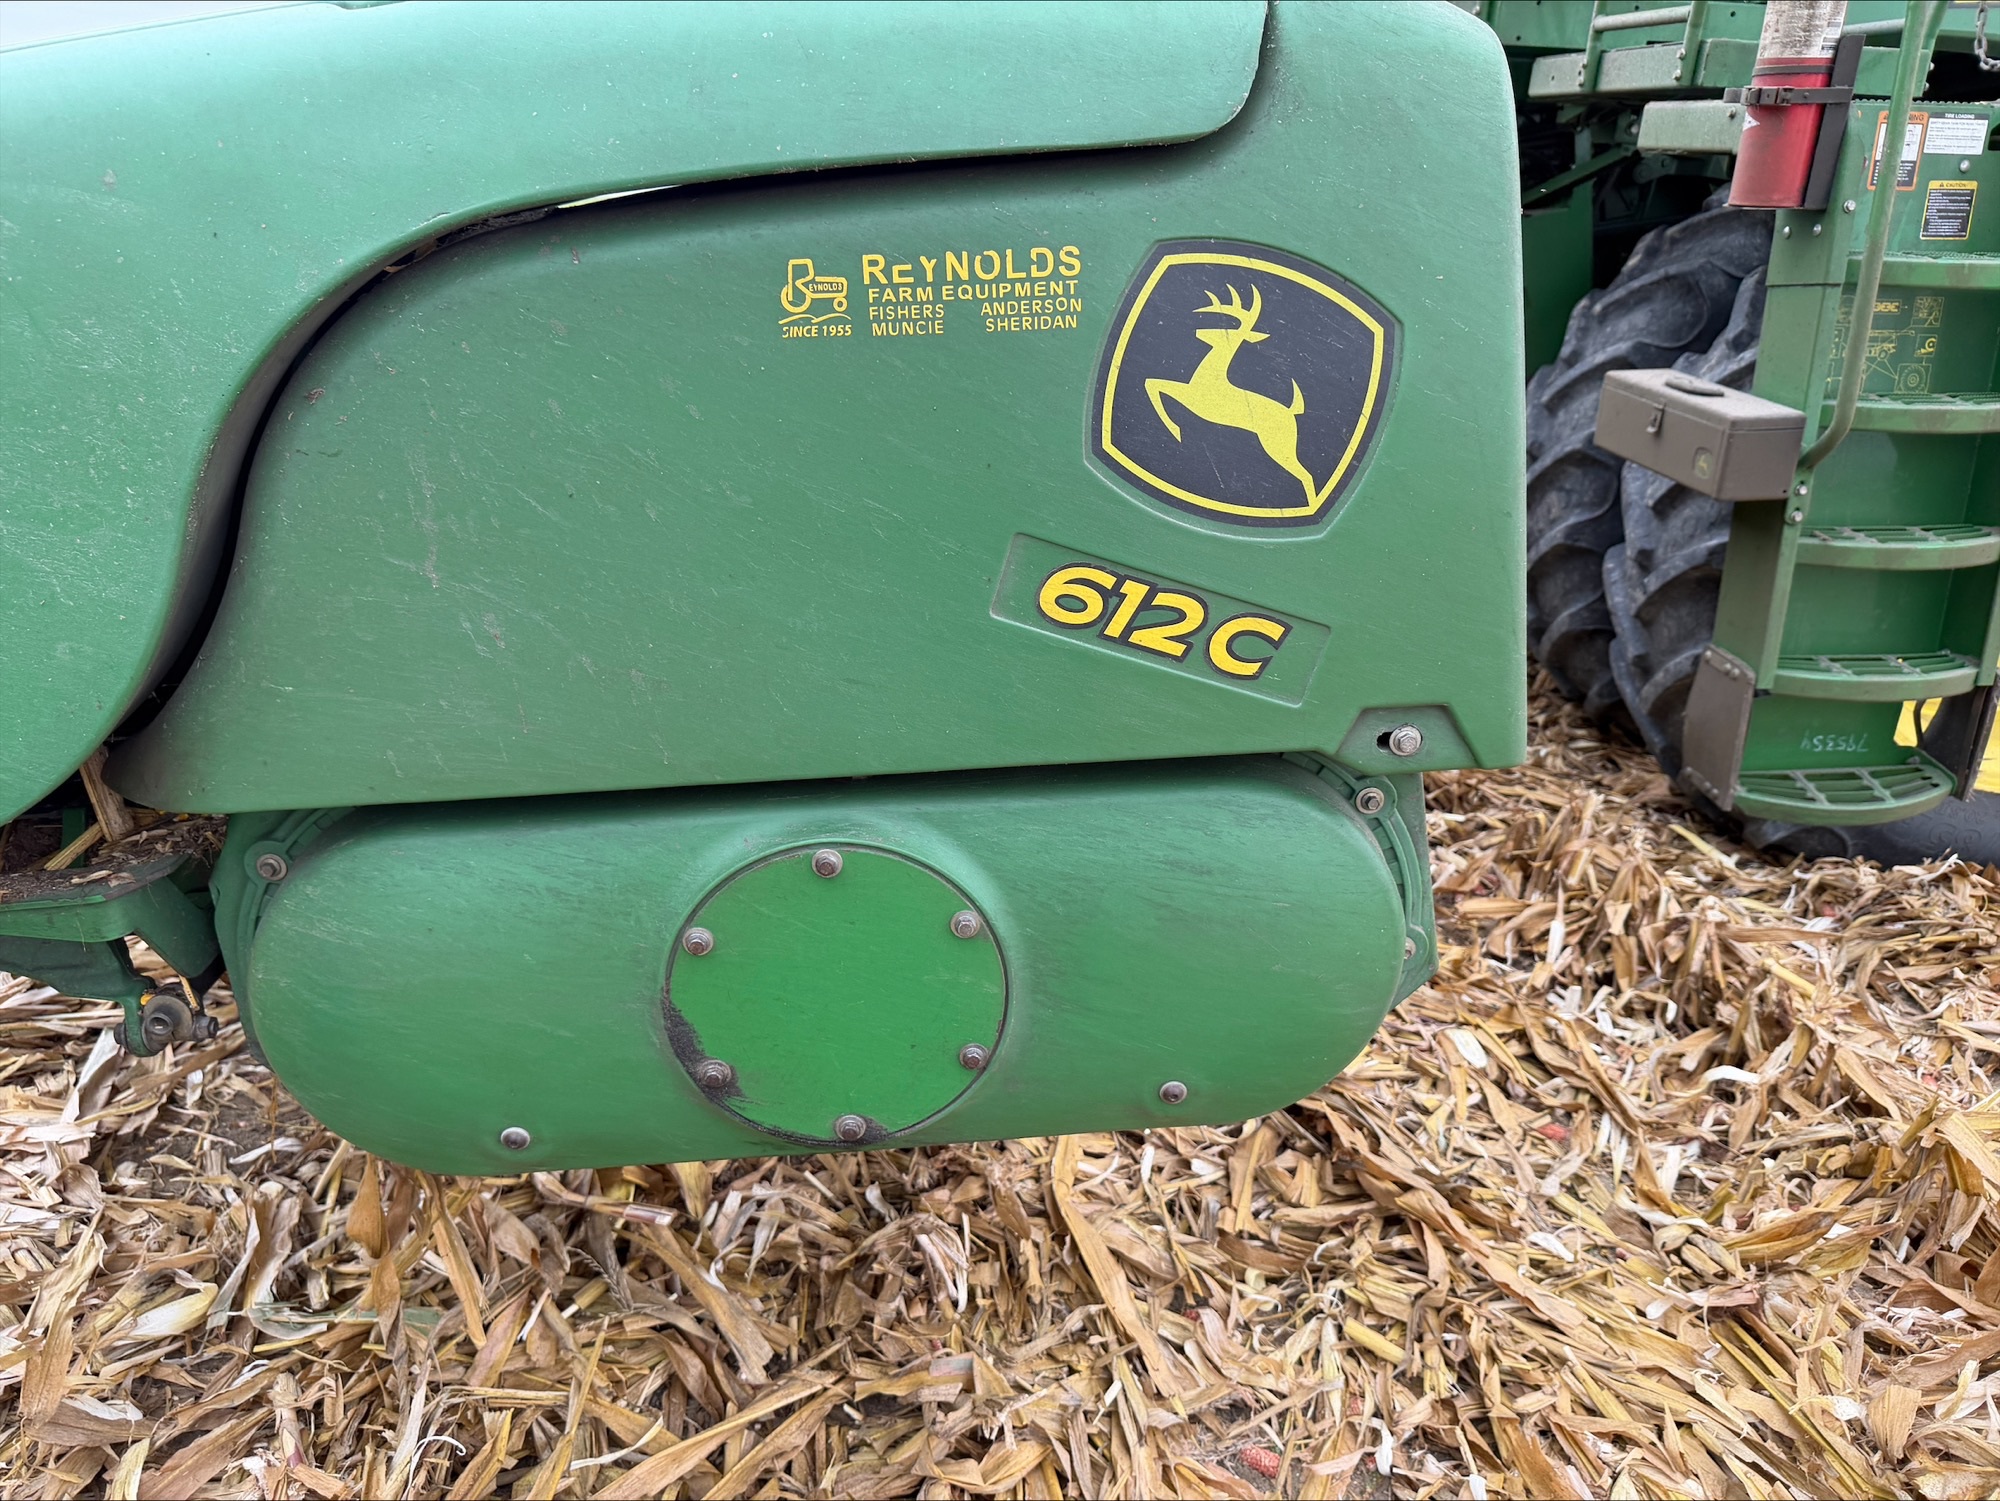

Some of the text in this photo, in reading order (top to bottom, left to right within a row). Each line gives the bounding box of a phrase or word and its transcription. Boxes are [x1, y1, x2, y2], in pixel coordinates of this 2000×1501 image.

[862, 246, 1081, 285] REYNOLDS
[868, 280, 1079, 303] FARM EQUIPMENT
[869, 303, 945, 320] FISHERS
[980, 297, 1082, 316] ANDERSON
[782, 324, 852, 338] SINCE 1955
[872, 320, 944, 337] MUNCIE
[985, 314, 1077, 332] SHERIDAN
